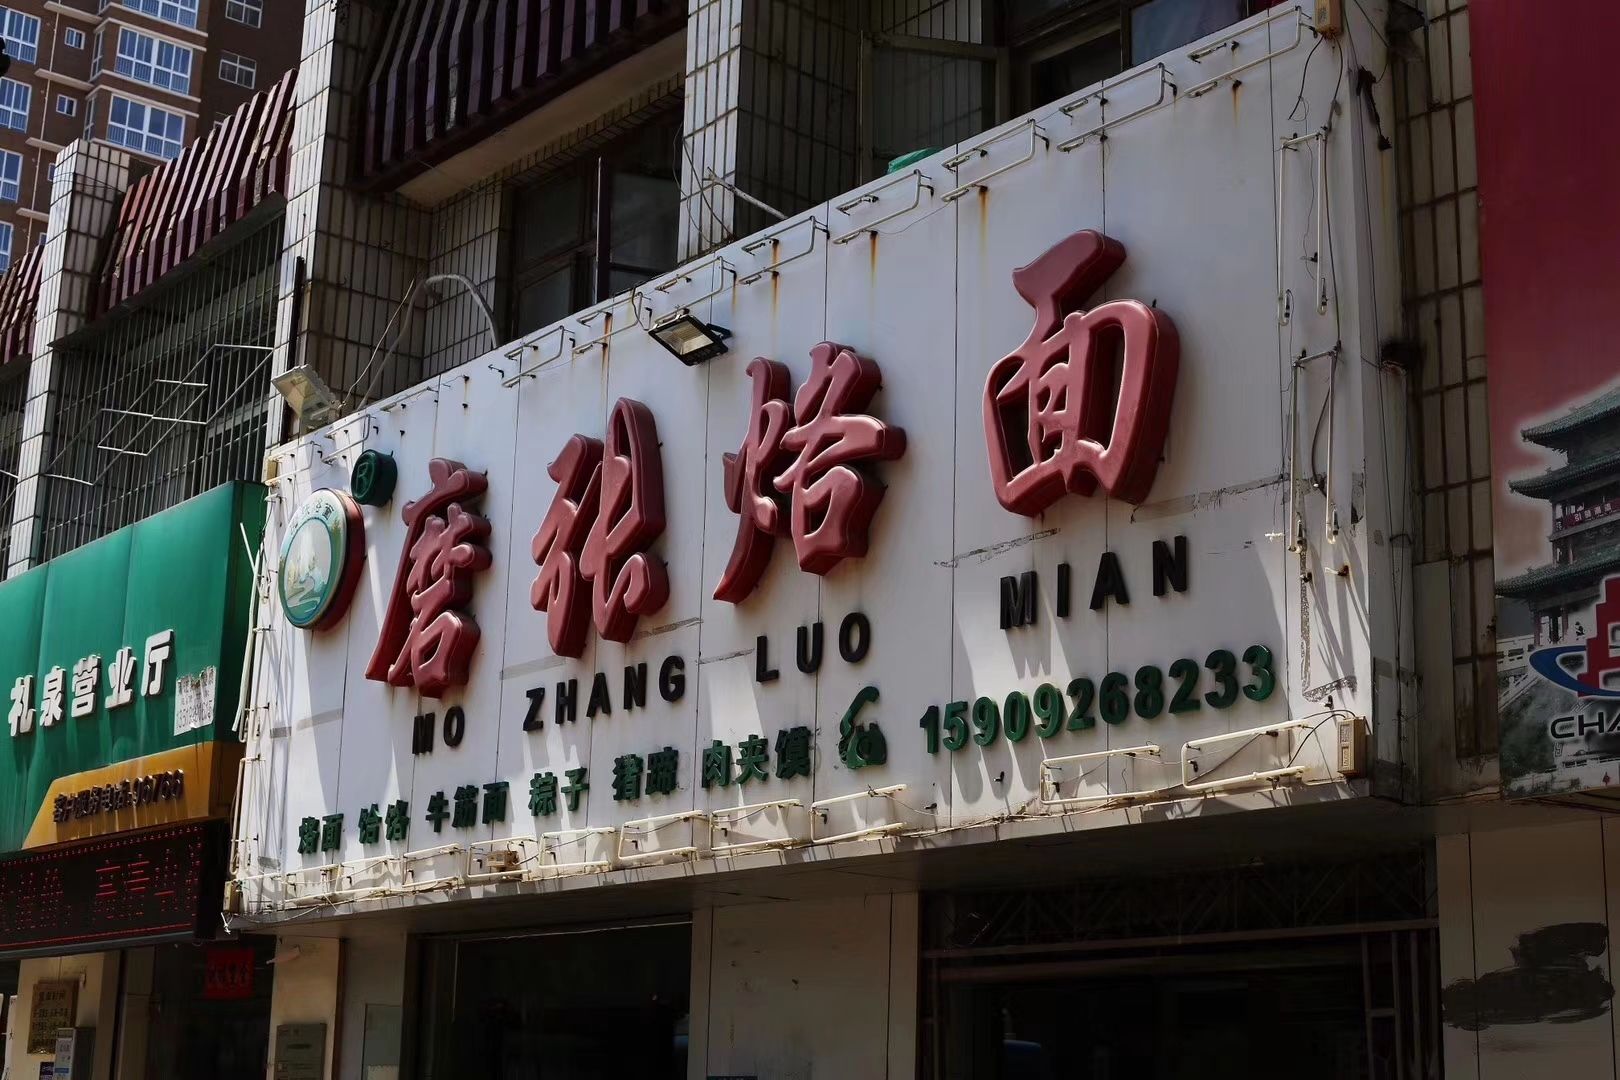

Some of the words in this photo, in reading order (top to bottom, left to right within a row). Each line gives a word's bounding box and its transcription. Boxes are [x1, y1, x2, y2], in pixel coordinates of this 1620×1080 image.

[8, 629, 174, 737] 礼泉营业厅
[523, 655, 685, 731] ZHANG
[756, 612, 870, 682] LUO
[1000, 535, 1187, 630] MIAN
[919, 644, 1277, 754] 15909268233
[425, 781, 510, 833] 牛筋面
[528, 766, 590, 817] 粽子
[701, 726, 812, 788] 肉夹馍
